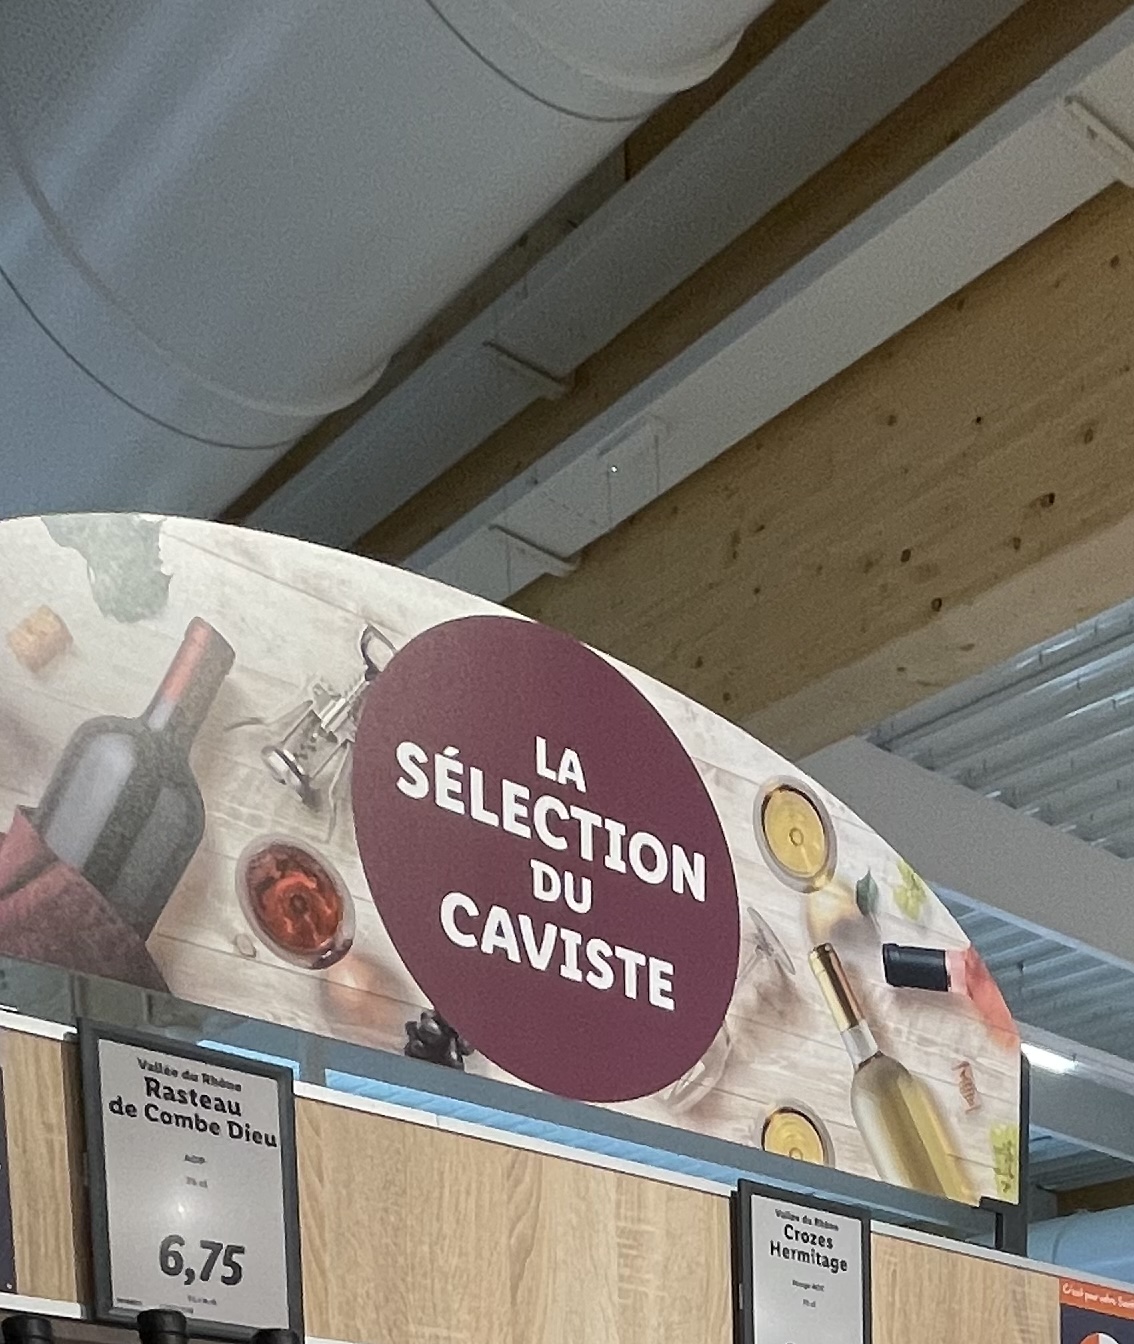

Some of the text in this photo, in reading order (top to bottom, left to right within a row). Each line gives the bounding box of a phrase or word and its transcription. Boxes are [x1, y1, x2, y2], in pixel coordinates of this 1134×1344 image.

[535, 735, 587, 793] LA
[396, 741, 706, 902] SÉLECTION
[530, 858, 593, 914] DU
[439, 891, 675, 1011] CAVISTE
[108, 1096, 278, 1148] de Combe Dieu
[144, 1076, 242, 1117] Rasteau
[159, 1234, 246, 1286] 6,75
[770, 1239, 848, 1274] Hermitage
[784, 1224, 834, 1249] Crozes
